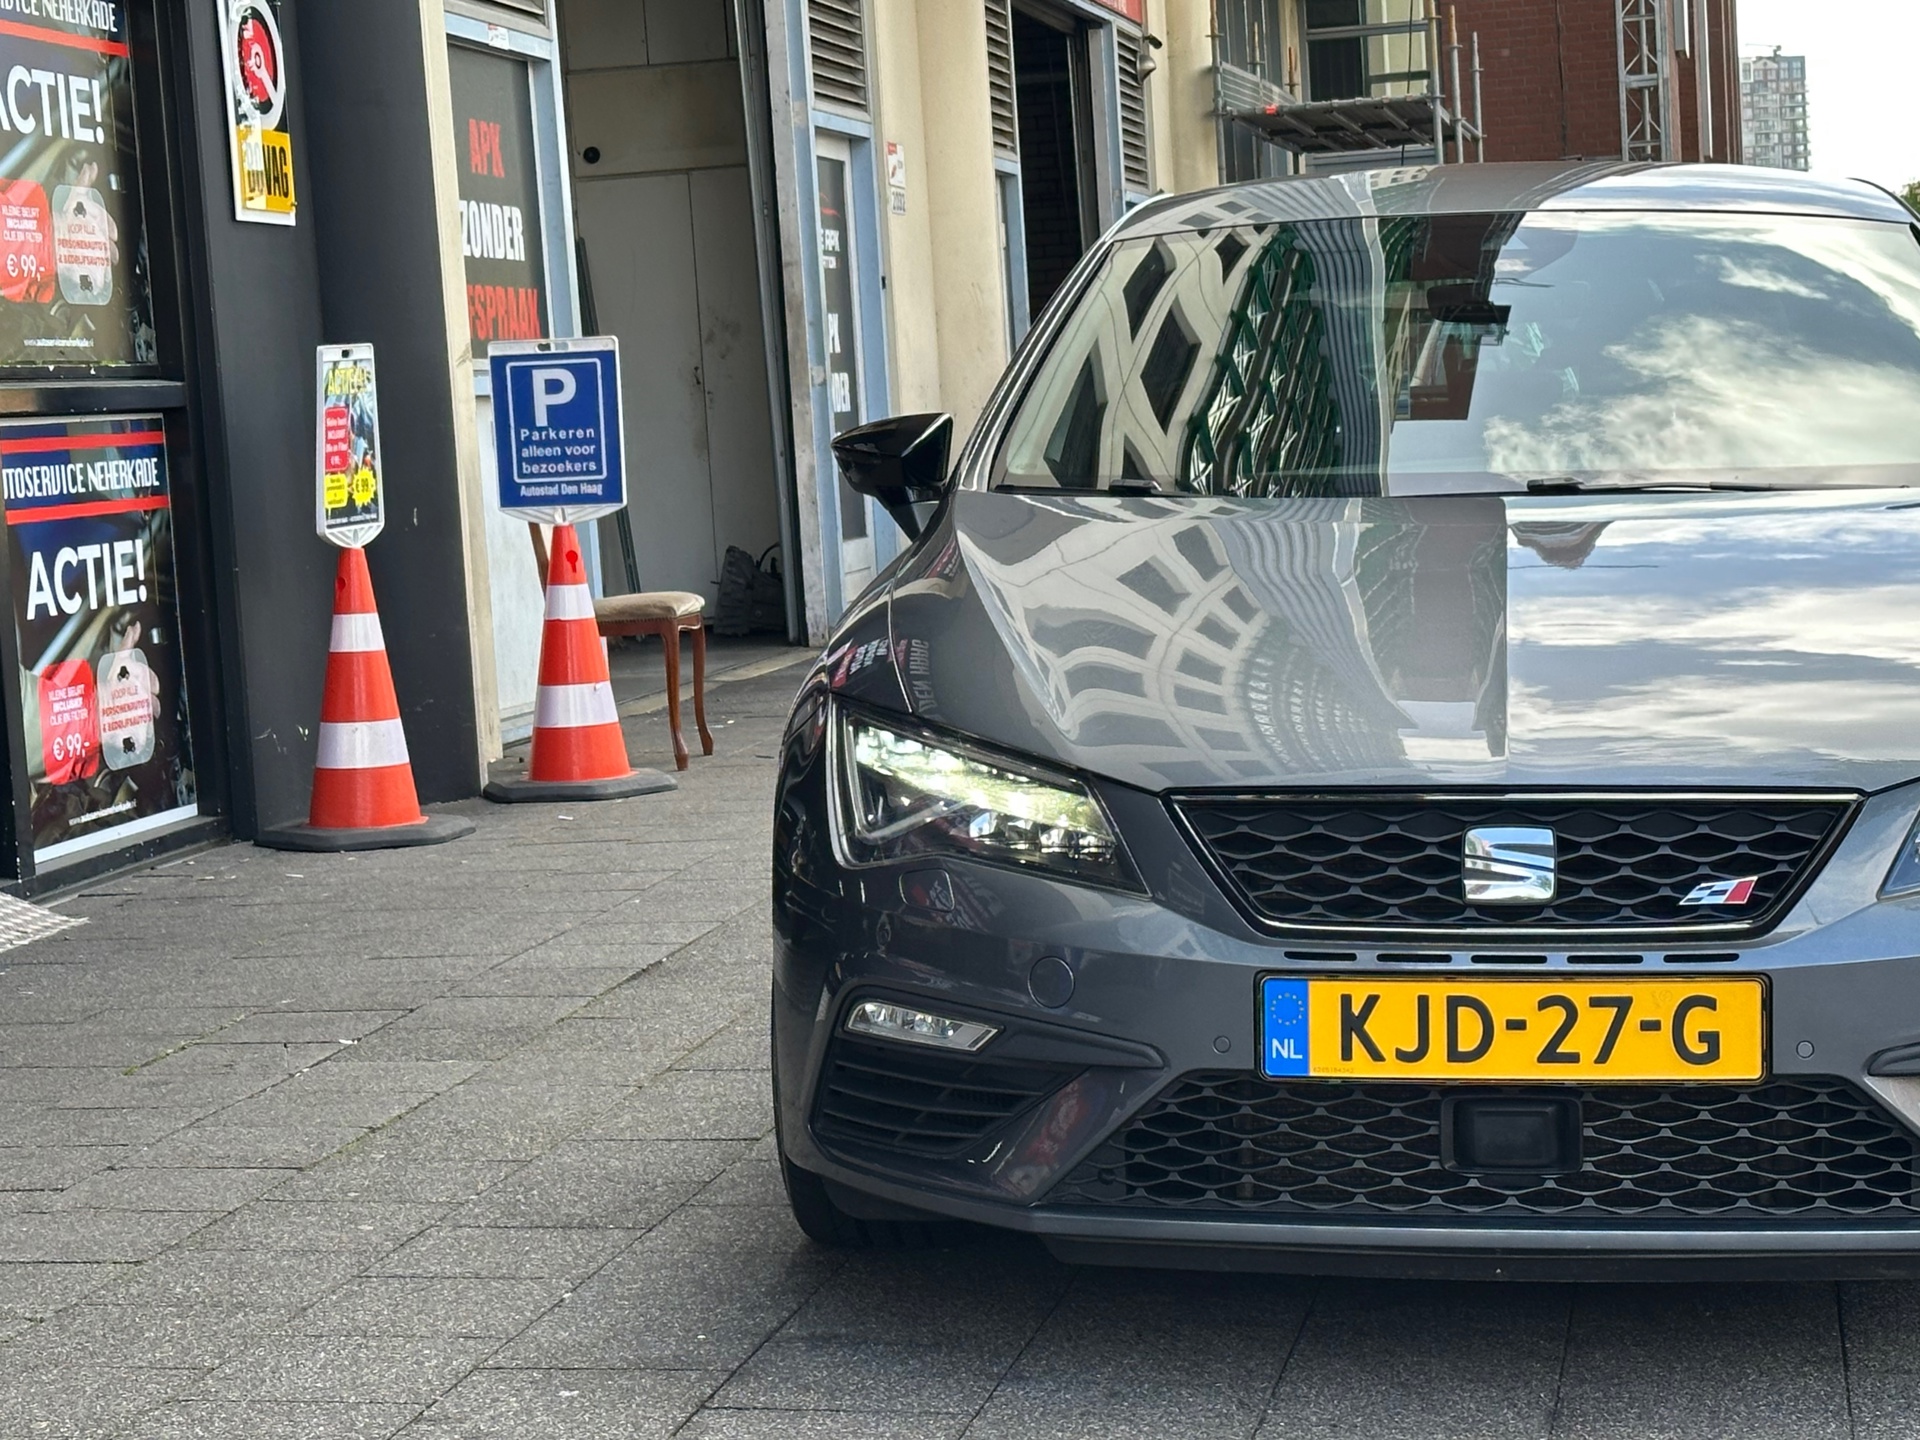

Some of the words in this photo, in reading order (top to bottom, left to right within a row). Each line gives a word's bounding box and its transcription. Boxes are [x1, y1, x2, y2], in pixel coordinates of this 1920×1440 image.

[468, 118, 505, 178] APK
[459, 199, 526, 262] ZONDER
[6, 253, 19, 277] €
[20, 254, 46, 282] 99,-
[532, 368, 577, 427] P
[520, 428, 595, 441] Parkeren
[521, 445, 562, 458] alleen
[564, 444, 596, 456] voor
[87, 458, 160, 493] NEHERKADE
[522, 460, 597, 474] bezoekers
[520, 484, 559, 497] Autostad
[561, 483, 579, 495] Den
[580, 482, 603, 496] Haag
[27, 539, 148, 620] ACTIE!
[53, 737, 65, 761] €
[66, 733, 91, 758] 99,-
[1339, 993, 1722, 1066] KJD-27-G
[1272, 1038, 1304, 1059] NL
